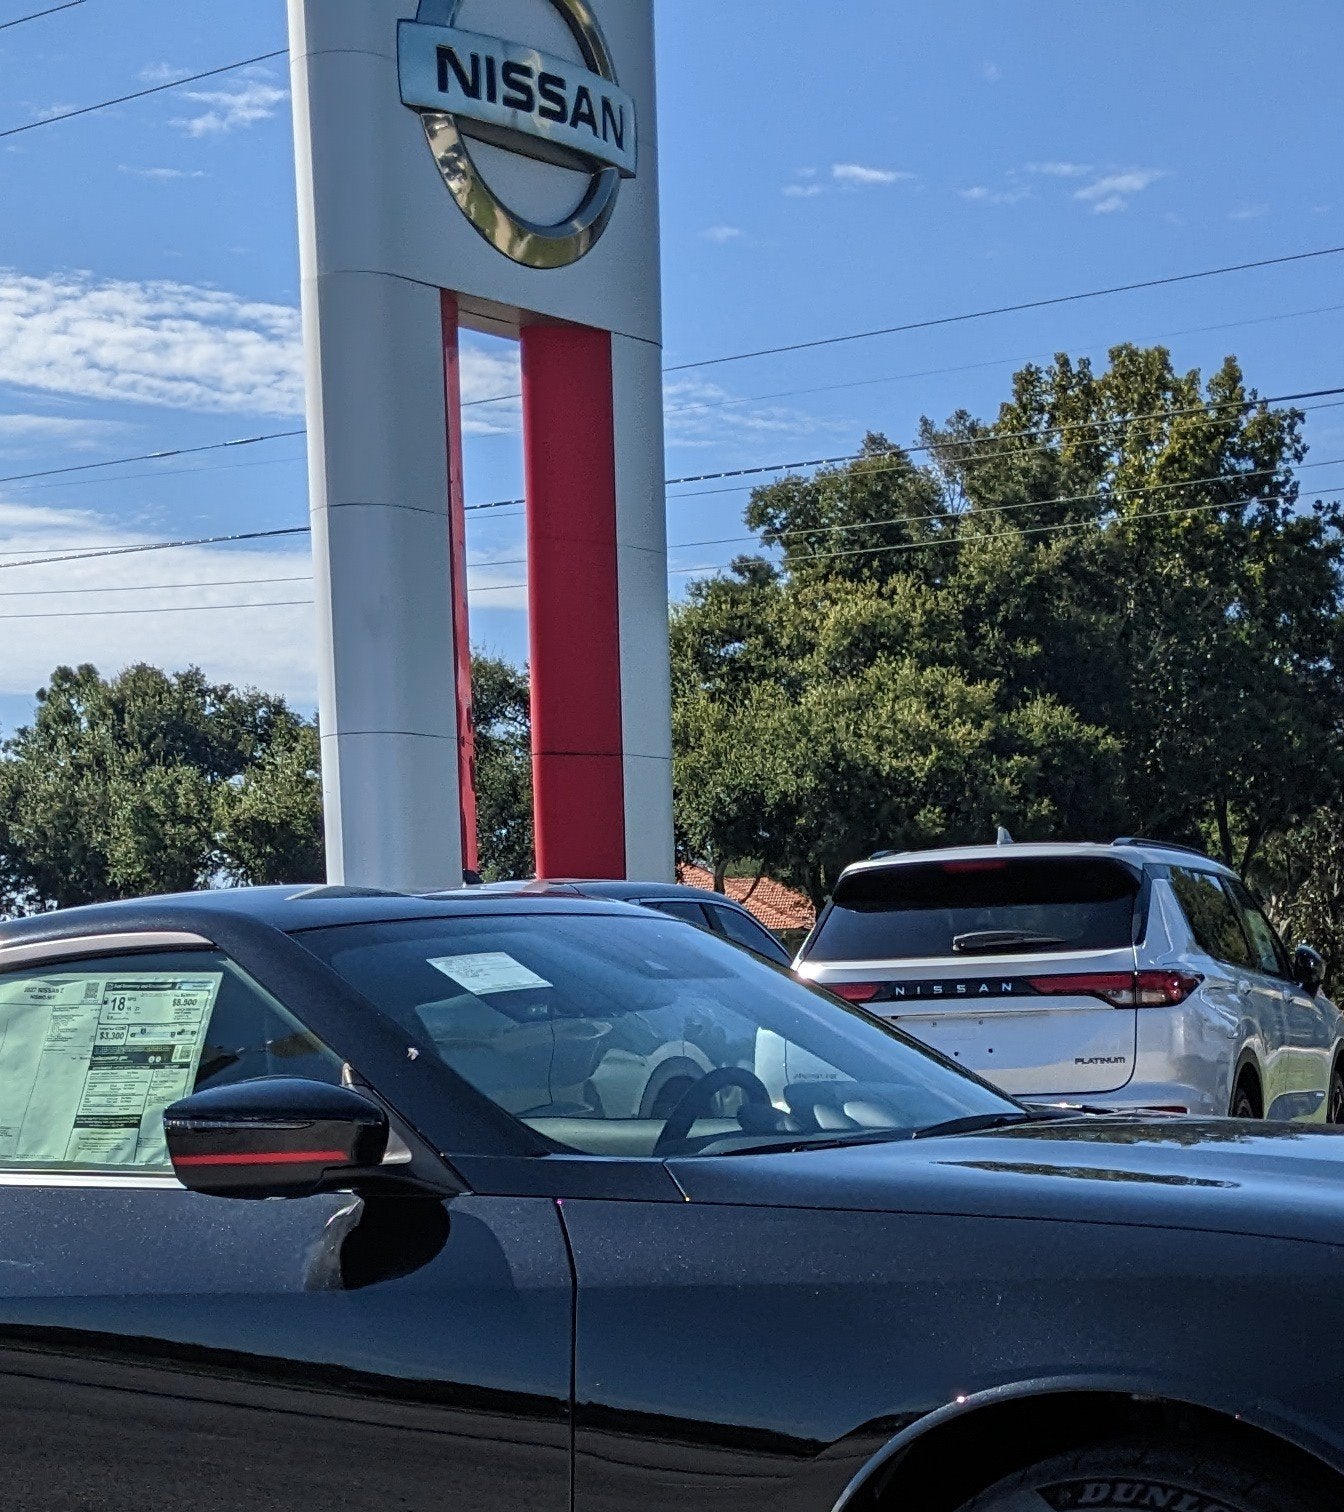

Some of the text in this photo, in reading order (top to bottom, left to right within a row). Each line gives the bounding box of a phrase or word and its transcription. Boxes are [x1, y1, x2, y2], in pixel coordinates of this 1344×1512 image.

[435, 44, 625, 151] NISSAN
[895, 982, 1013, 996] NISSAN
[111, 996, 126, 1011] 18
[1075, 1056, 1126, 1065] PLATINUM
